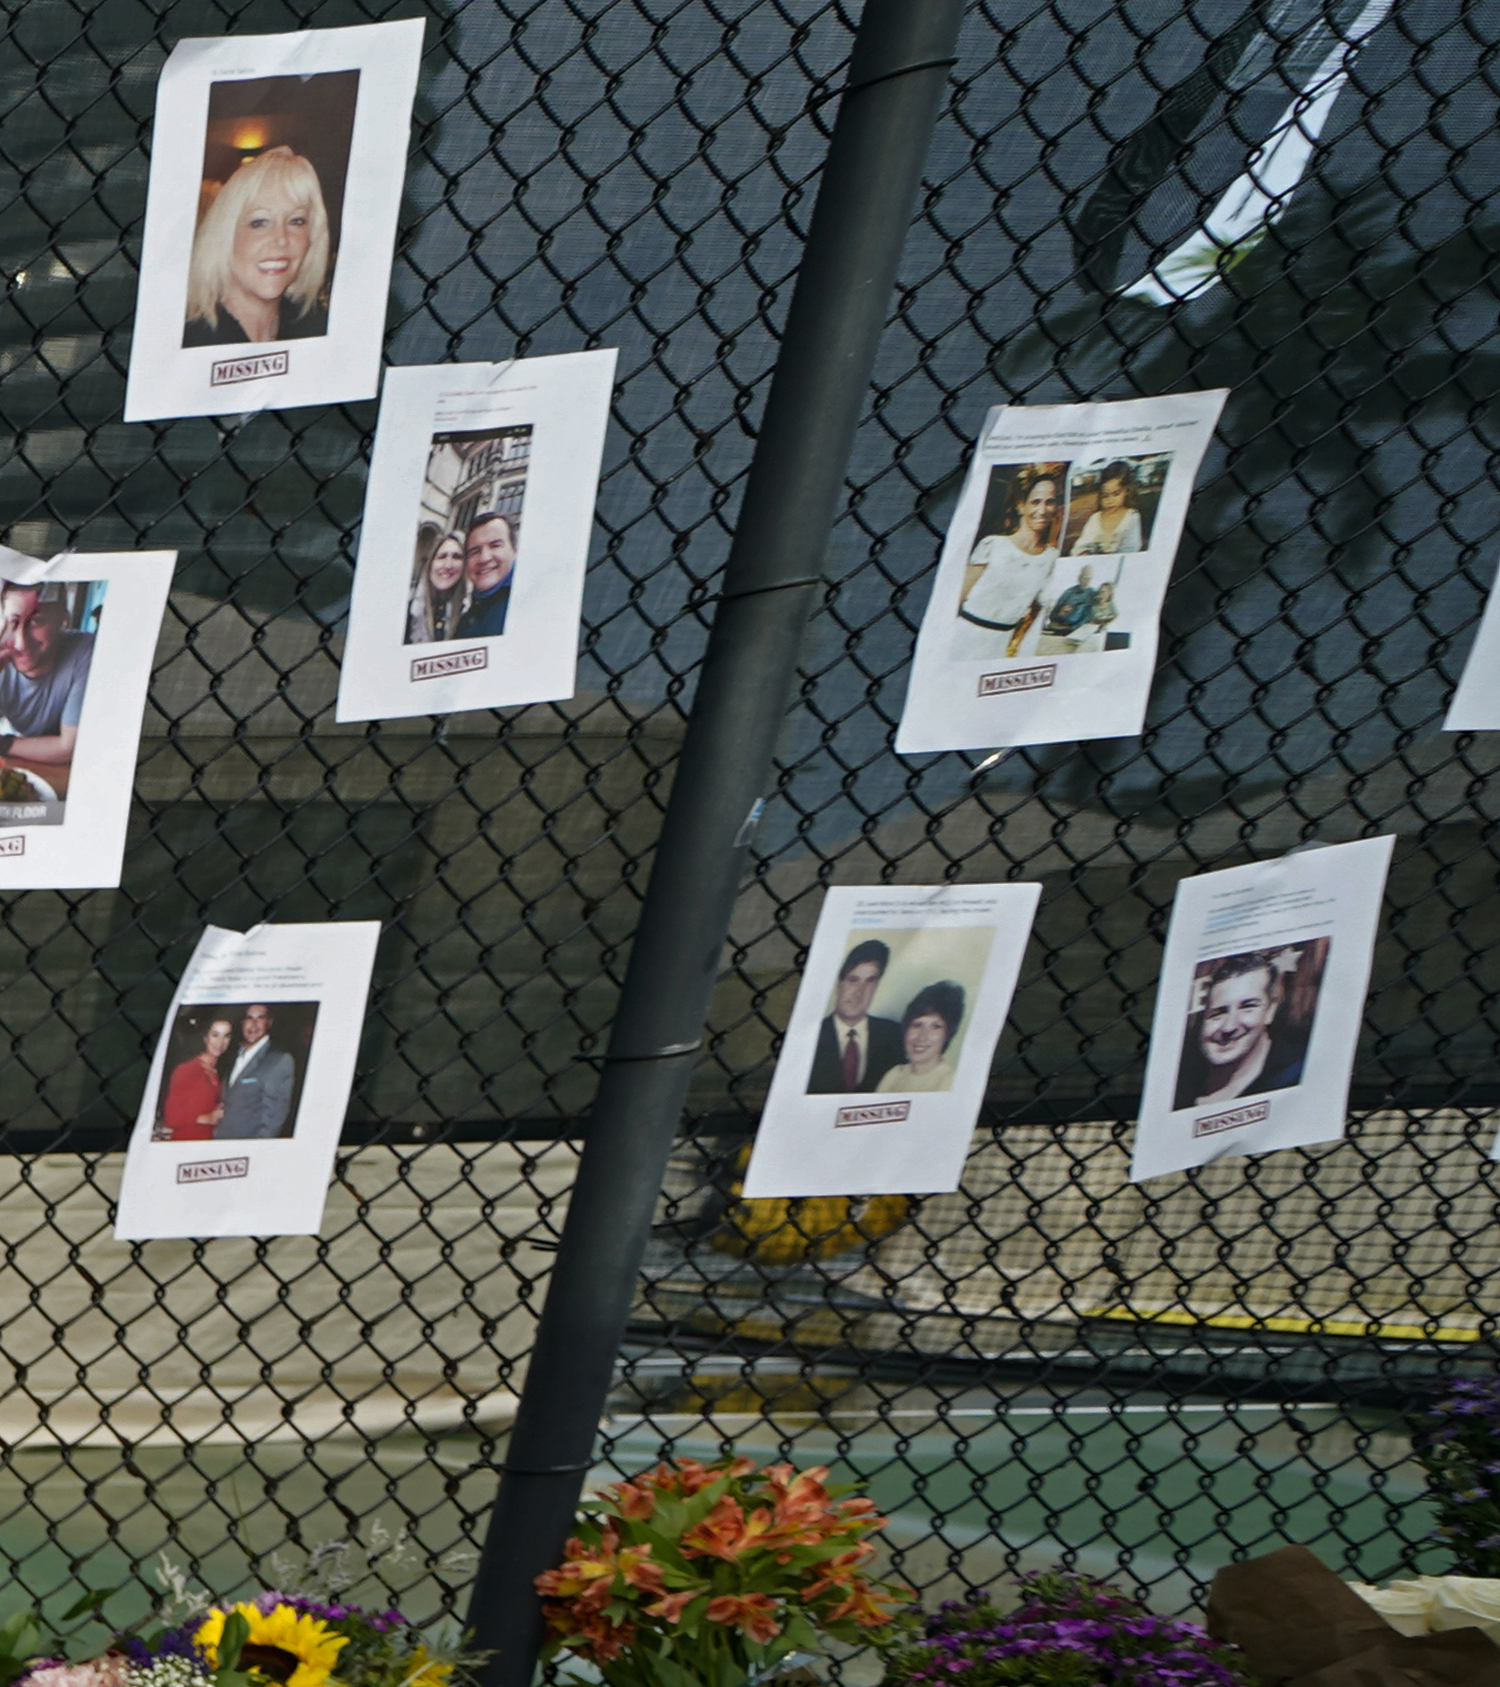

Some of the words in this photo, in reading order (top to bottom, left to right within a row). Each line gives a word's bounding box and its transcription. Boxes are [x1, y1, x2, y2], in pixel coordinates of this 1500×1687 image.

[214, 355, 285, 382] MISSING
[414, 651, 484, 677] MISSING
[982, 668, 1052, 691] MISSING
[180, 1161, 245, 1180] MISSING
